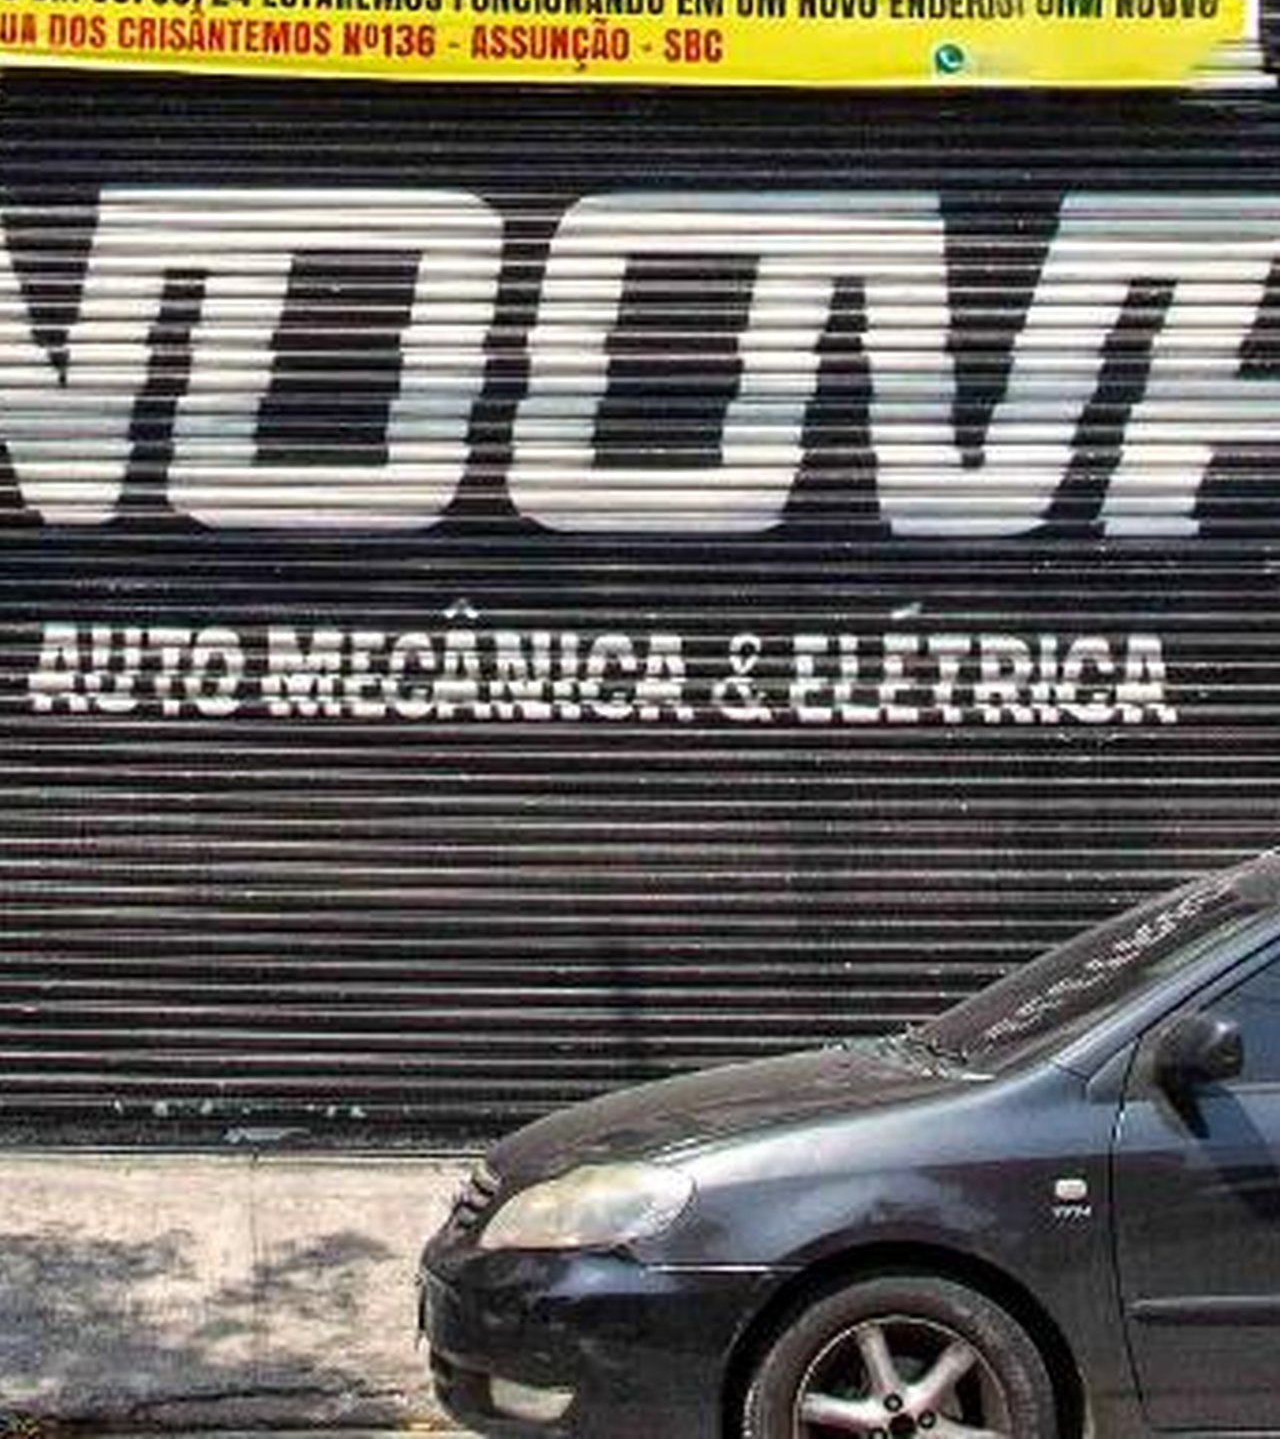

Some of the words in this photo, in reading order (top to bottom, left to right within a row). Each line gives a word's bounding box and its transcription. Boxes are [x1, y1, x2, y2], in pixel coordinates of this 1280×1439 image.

[49, 13, 107, 50] DOS
[117, 4, 332, 57] CRISÂNTEMOS
[470, 17, 631, 72] ASSUNÇÃO
[663, 28, 724, 64] SBC
[28, 625, 246, 717] AUTO
[261, 597, 696, 721] MECÂNICA
[711, 633, 773, 722] &
[788, 601, 1178, 724] ELÉTRICA
